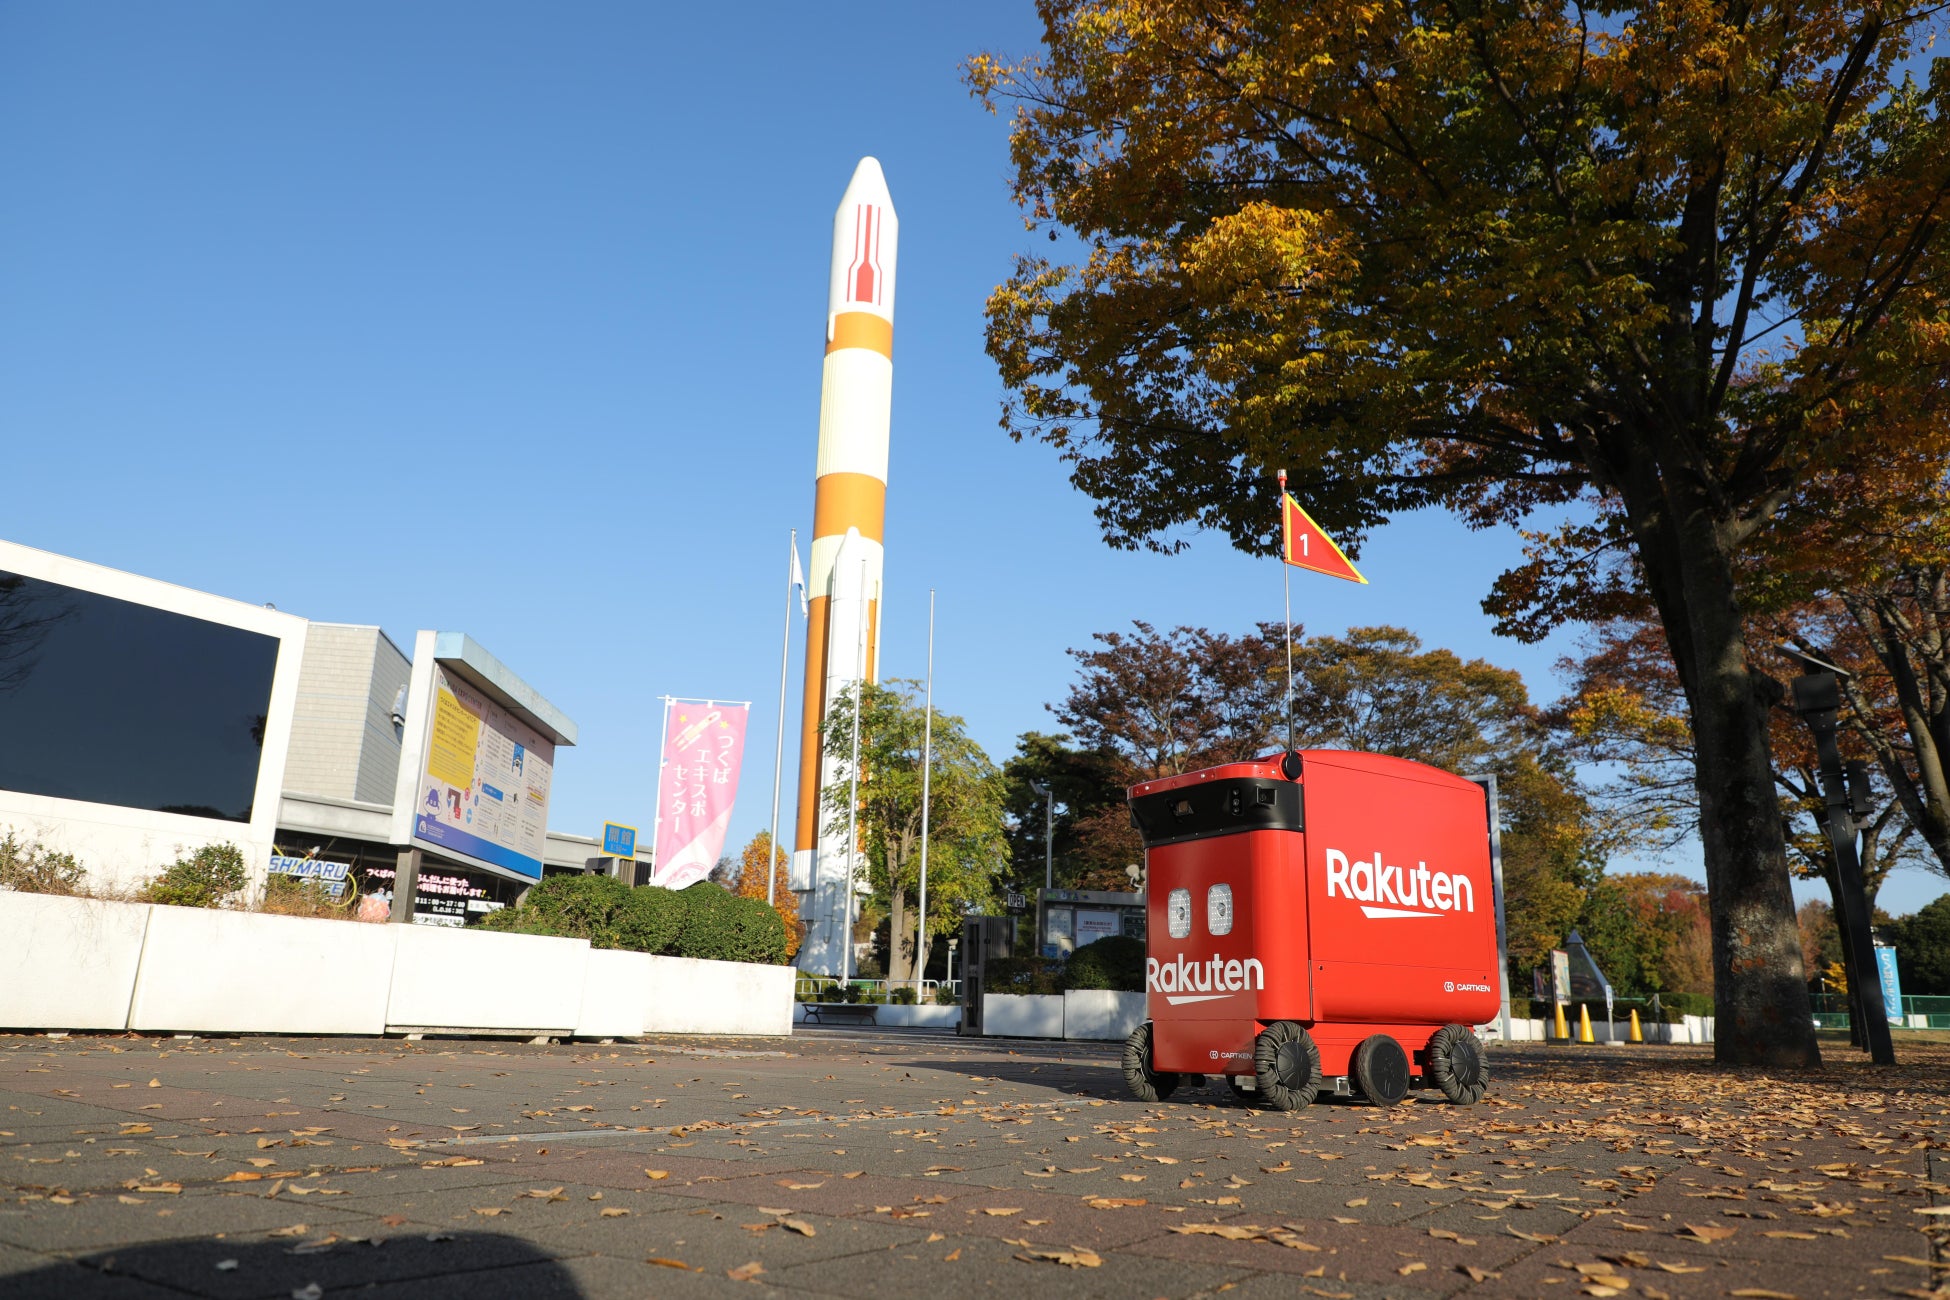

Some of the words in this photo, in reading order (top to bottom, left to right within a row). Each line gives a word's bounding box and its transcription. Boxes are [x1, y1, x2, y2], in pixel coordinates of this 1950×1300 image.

[1299, 533, 1309, 557] 1
[713, 735, 735, 784] つくば
[672, 763, 689, 833] センター
[690, 749, 711, 817] エキスポ
[1009, 894, 1024, 907] OPEN
[1326, 848, 1474, 913] Rakuten
[1145, 953, 1264, 993] Rakuten
[1457, 983, 1491, 992] CARTKEN
[1220, 1052, 1253, 1060] CARTKEN
